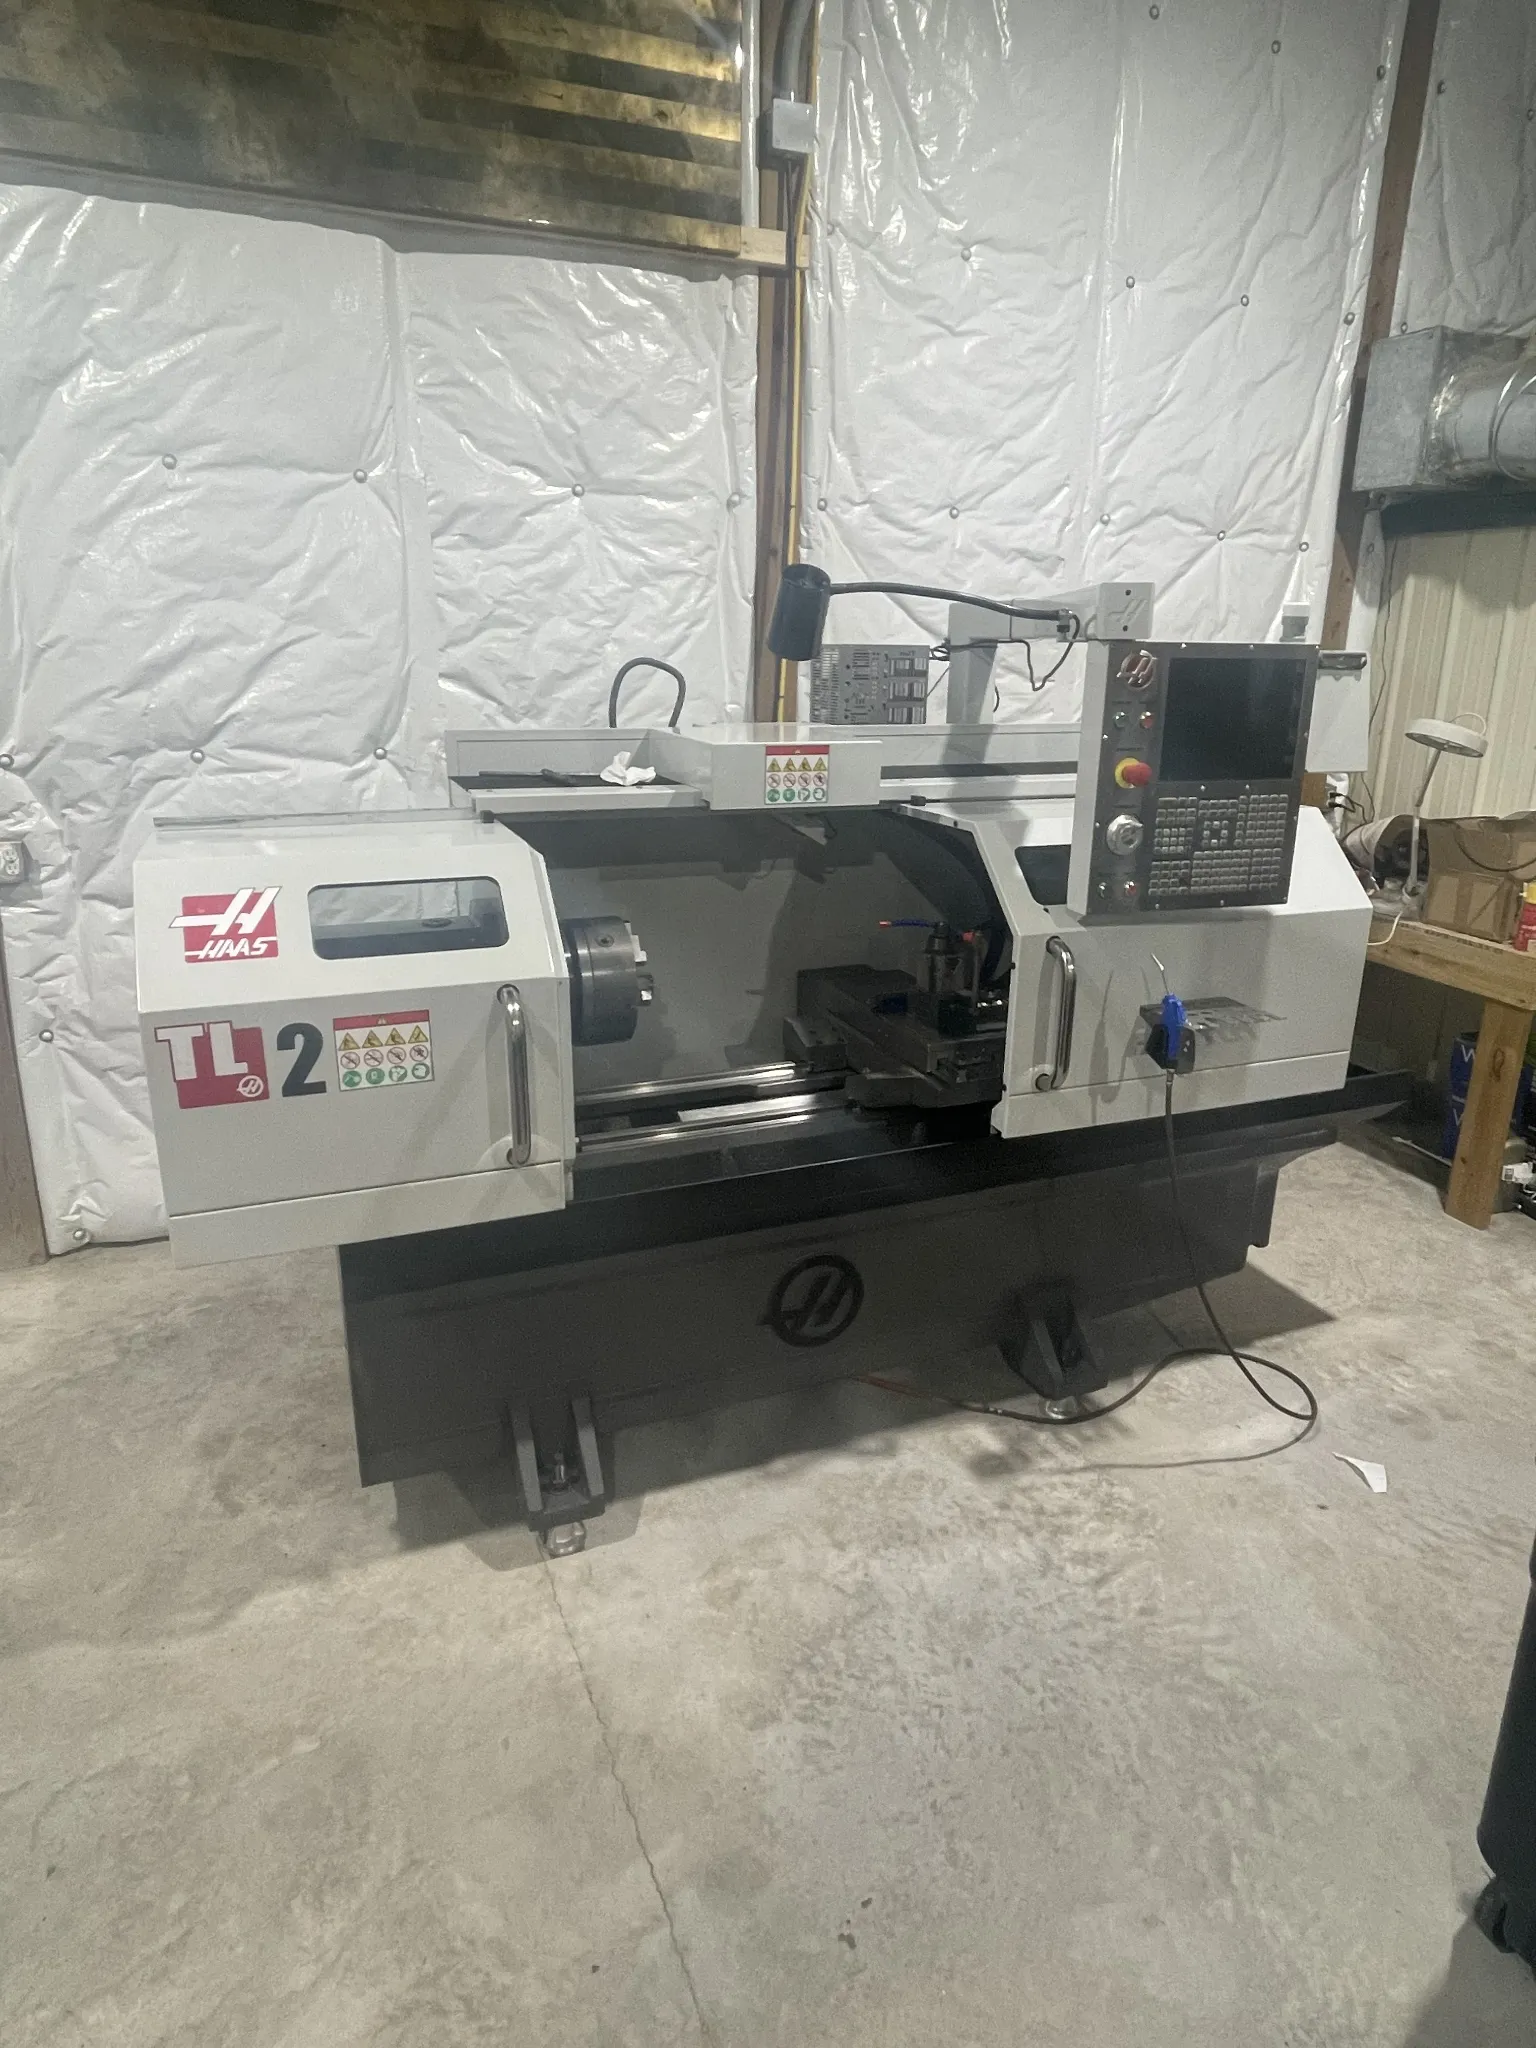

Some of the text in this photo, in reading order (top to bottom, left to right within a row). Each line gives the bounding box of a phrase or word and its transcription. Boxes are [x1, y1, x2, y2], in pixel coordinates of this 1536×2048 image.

[189, 936, 274, 959] HAAS
[155, 1020, 327, 1097] TL 2
